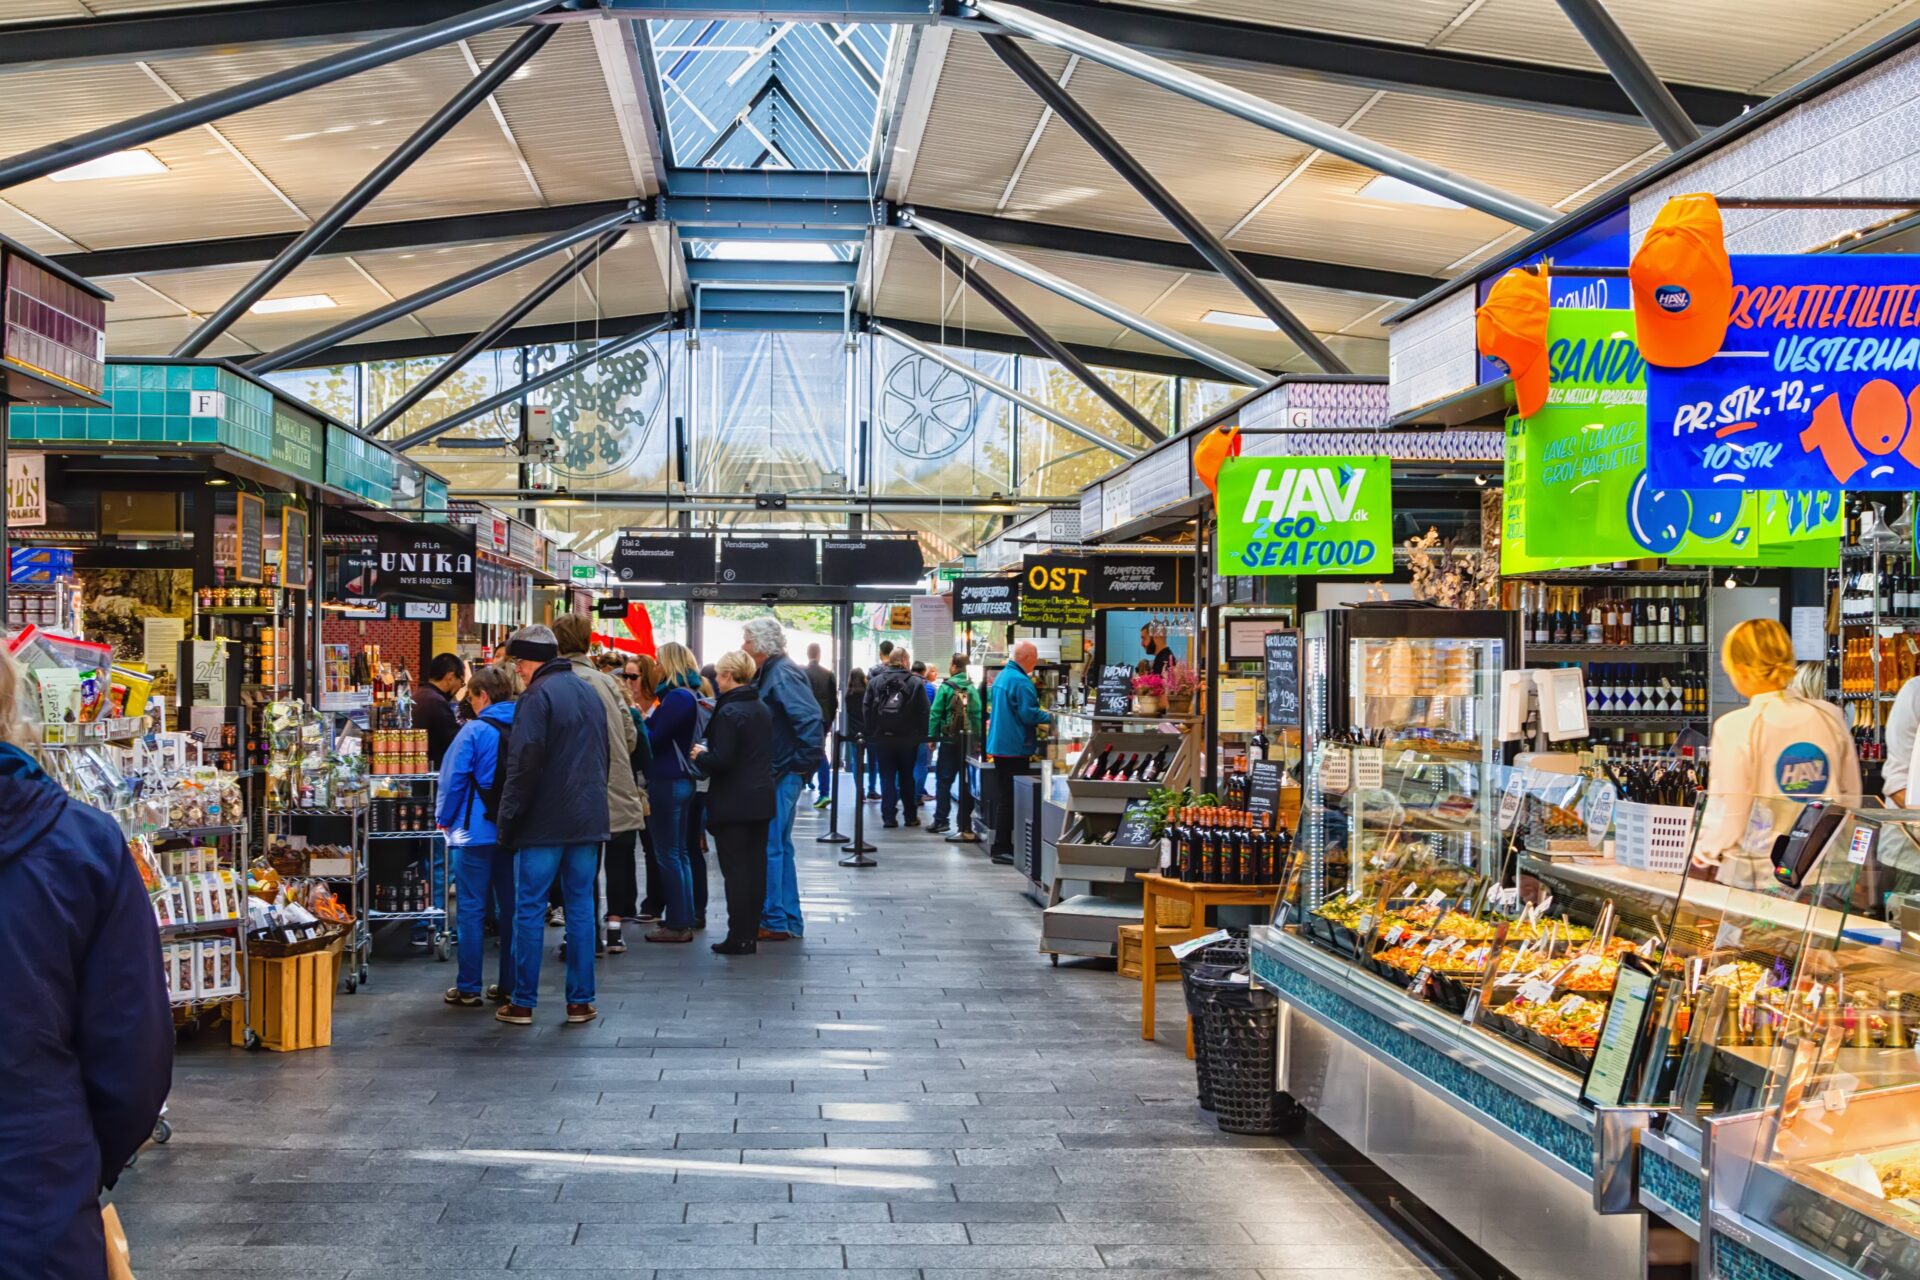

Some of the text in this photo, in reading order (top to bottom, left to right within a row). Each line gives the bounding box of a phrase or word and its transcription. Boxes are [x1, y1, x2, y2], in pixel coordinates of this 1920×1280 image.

[1774, 335, 1920, 373] VESTERHA
[199, 396, 210, 413] F
[1293, 412, 1308, 429] G
[1702, 442, 1783, 470] 10 STK
[1054, 524, 1063, 535] G
[1252, 516, 1315, 539] 2 GO
[724, 541, 769, 549] Vendersgade
[381, 552, 472, 573] UNIKA
[1029, 565, 1087, 593] OST
[962, 602, 1012, 614] DELIKATESSER
